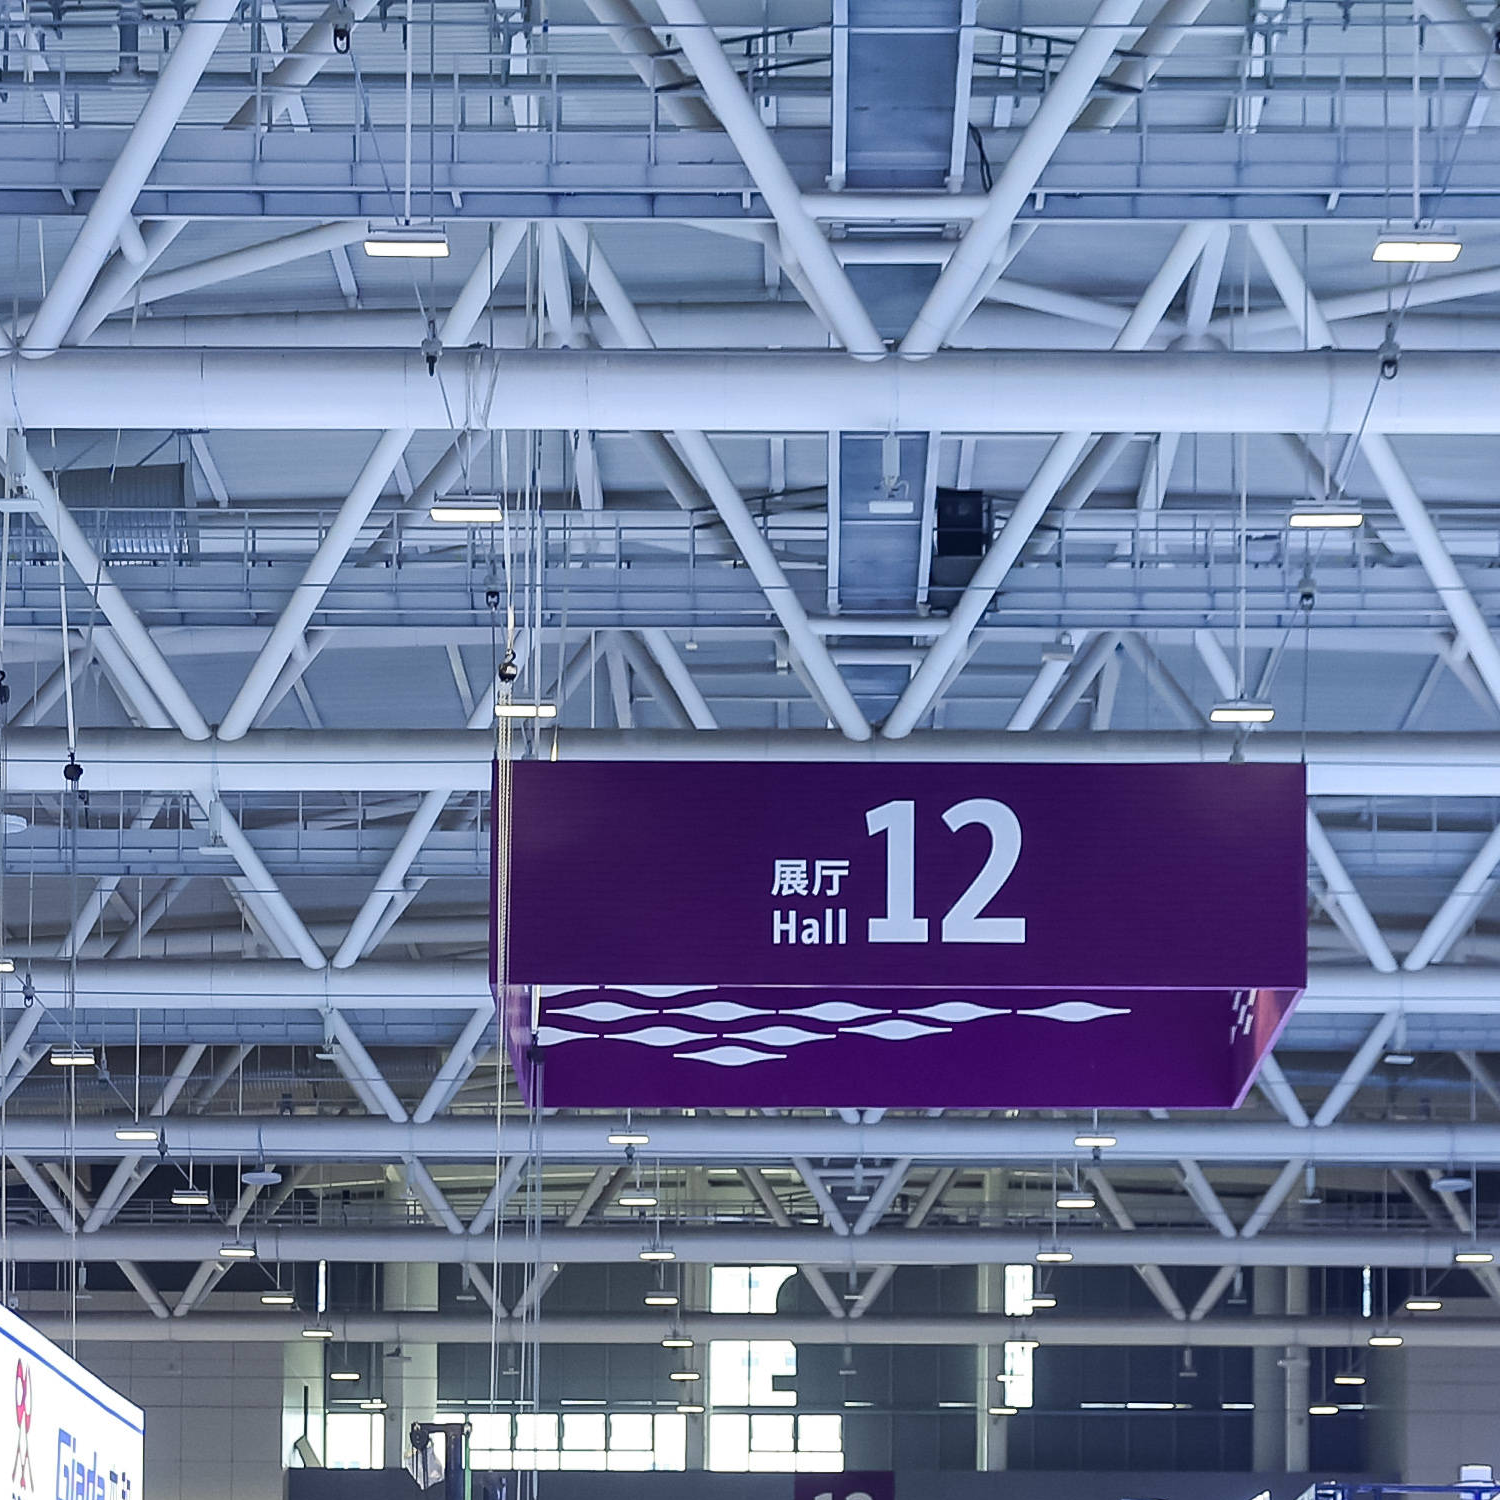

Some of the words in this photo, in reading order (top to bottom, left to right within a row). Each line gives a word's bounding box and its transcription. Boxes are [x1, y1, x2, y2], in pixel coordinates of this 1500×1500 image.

[771, 909, 849, 945] Hall
[864, 798, 1027, 945] 12
[771, 859, 850, 896] 展厅
